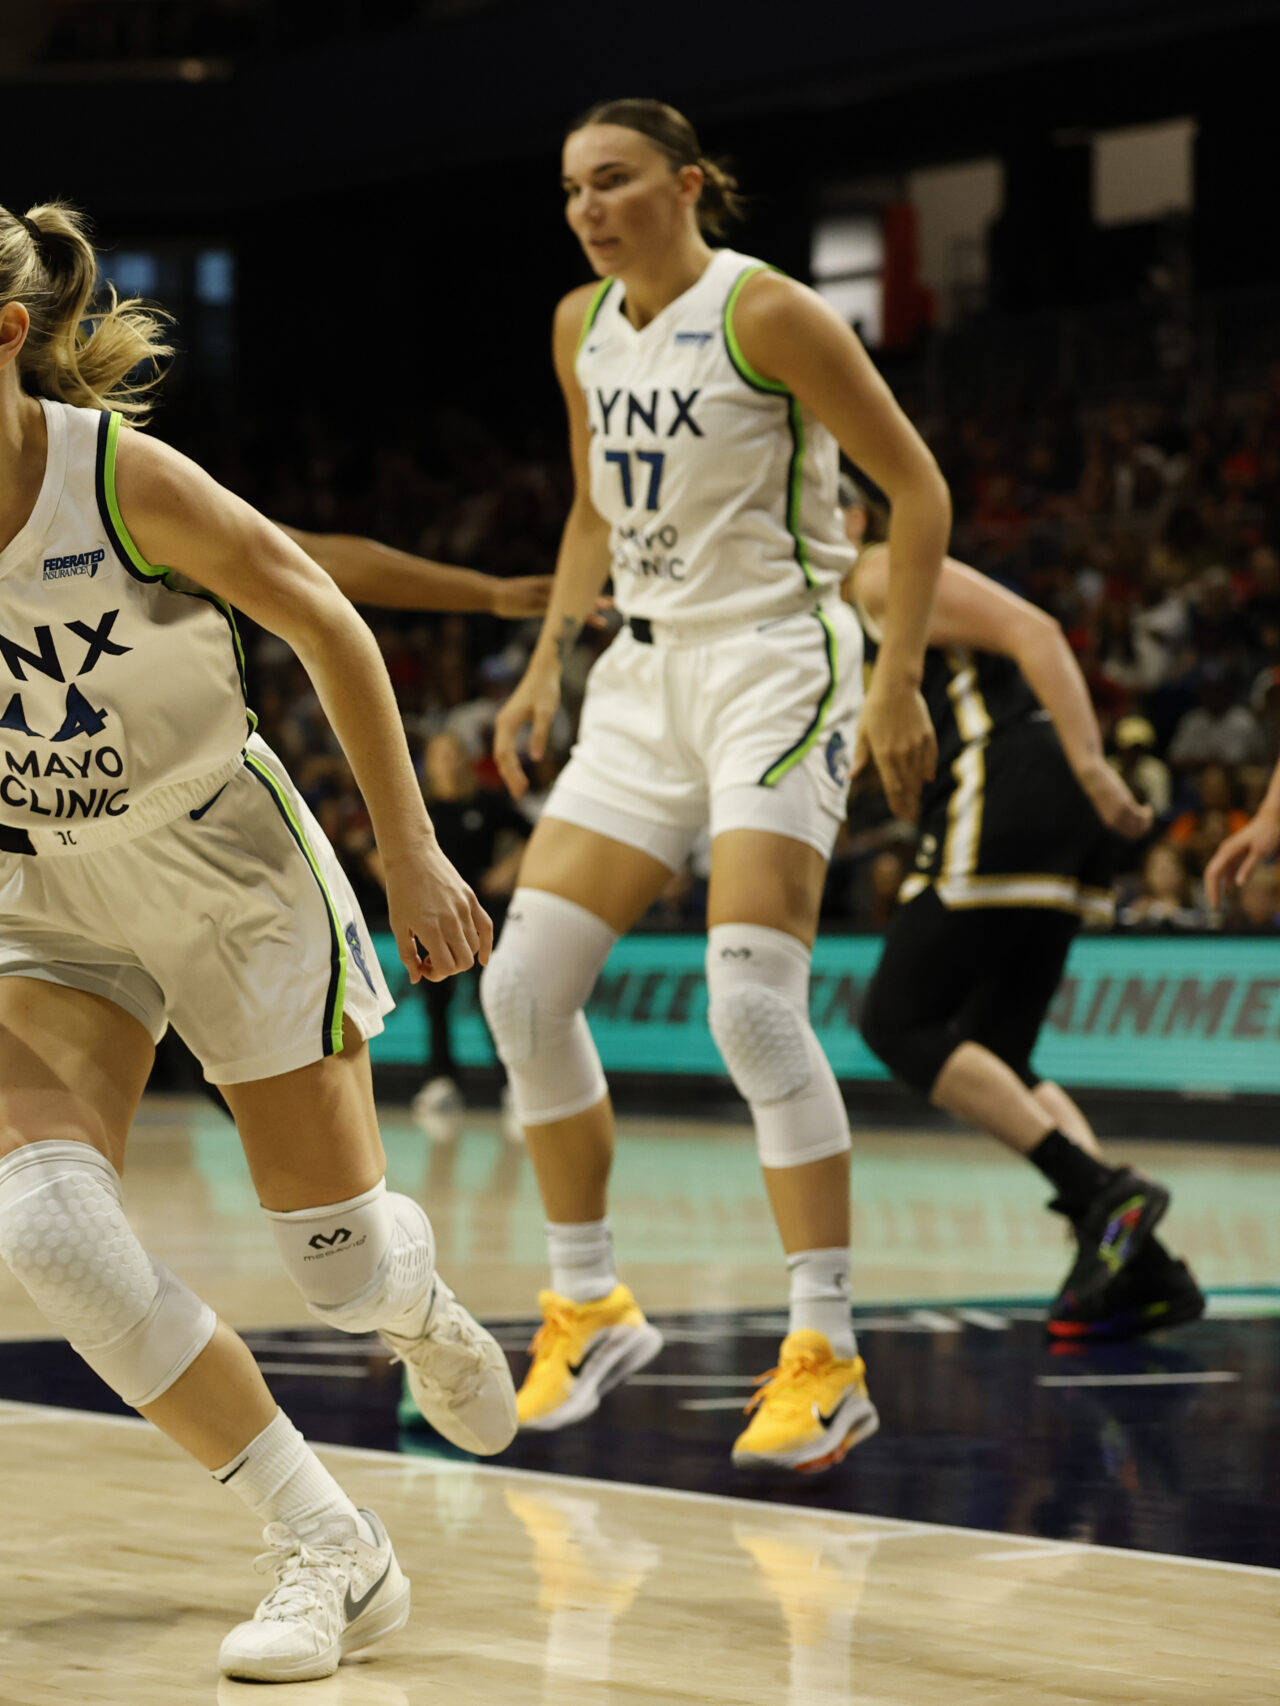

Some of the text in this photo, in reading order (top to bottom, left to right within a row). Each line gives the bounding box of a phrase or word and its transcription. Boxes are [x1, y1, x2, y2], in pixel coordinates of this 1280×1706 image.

[591, 387, 705, 437] YNX
[605, 450, 665, 510] 77
[43, 548, 105, 571] FEDERATED
[43, 566, 88, 581] INSURANCE
[5, 746, 123, 778] MAYO
[0, 775, 130, 819] CLINIC
